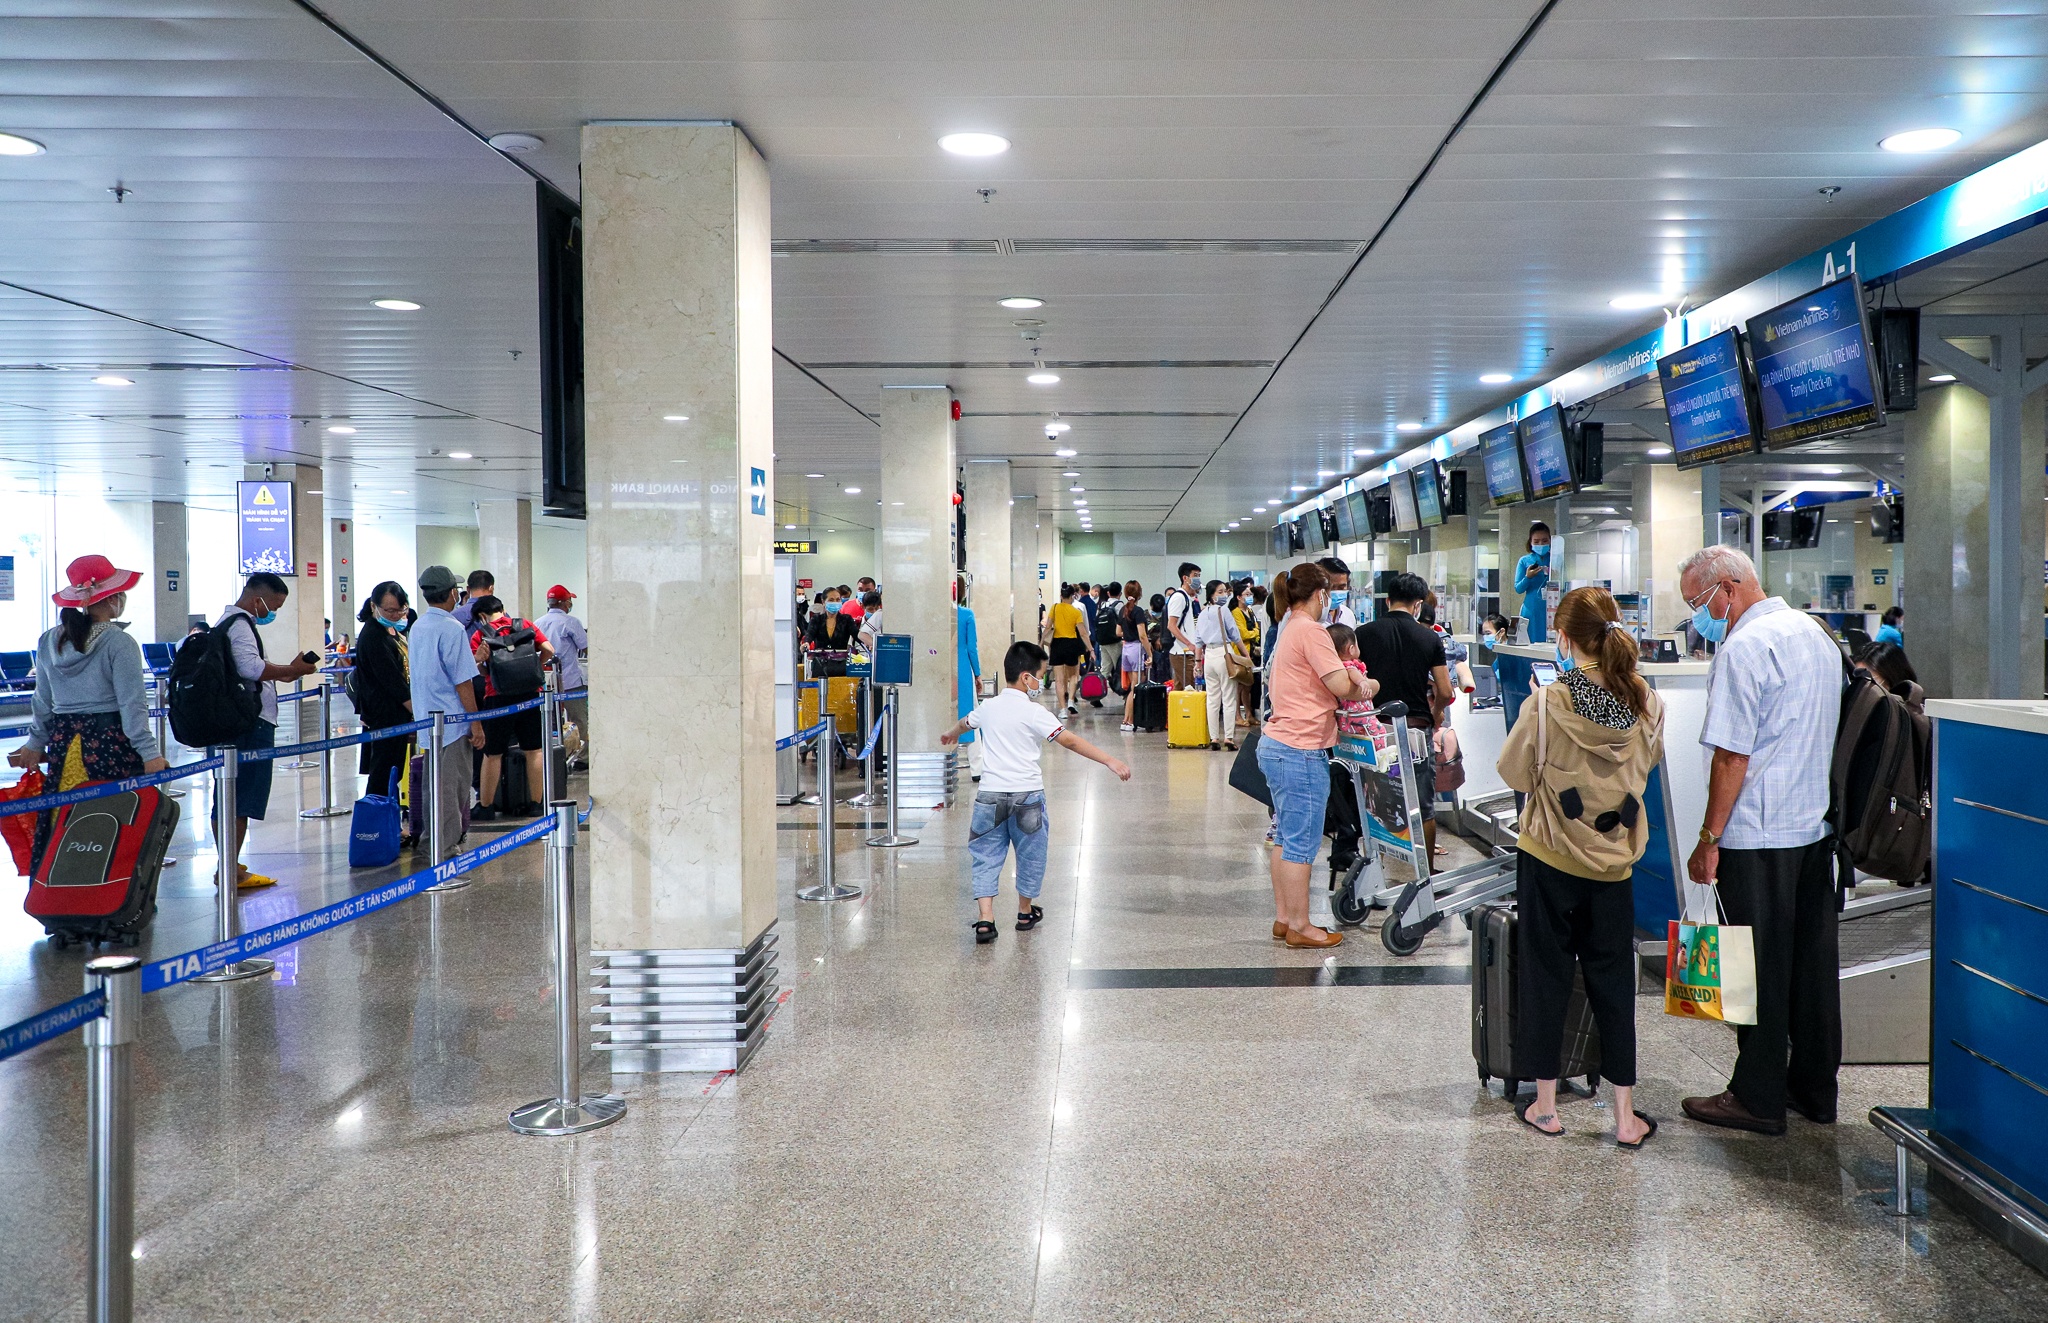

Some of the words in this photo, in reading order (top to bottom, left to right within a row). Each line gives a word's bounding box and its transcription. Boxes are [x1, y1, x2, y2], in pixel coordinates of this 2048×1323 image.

[1822, 241, 1856, 286] A-1
[1775, 319, 1805, 338] Vietnam
[1803, 307, 1829, 327] Airlines
[1603, 360, 1628, 380] Vietnam
[1628, 350, 1650, 369] Airlines
[1790, 378, 1808, 398] Family
[1808, 375, 1833, 394] Check-in
[370, 730, 382, 740] TIA
[241, 751, 259, 761] TIA
[118, 778, 139, 792] TIA
[66, 841, 103, 852] Polo
[478, 849, 490, 860] TAN
[490, 843, 502, 855] SON
[501, 836, 515, 850] NHAT
[515, 822, 550, 843] INTERNATIONAL
[433, 861, 457, 881] TIA
[244, 932, 272, 952] CẢNG
[273, 923, 299, 942] HÀNG
[300, 911, 330, 932] KHÔNG
[331, 901, 354, 921] QUỐC
[355, 896, 365, 912] TẾ
[366, 893, 380, 908] TÂN
[381, 887, 397, 902] SƠN
[397, 878, 416, 896] NHẤT
[160, 953, 202, 983] TIA
